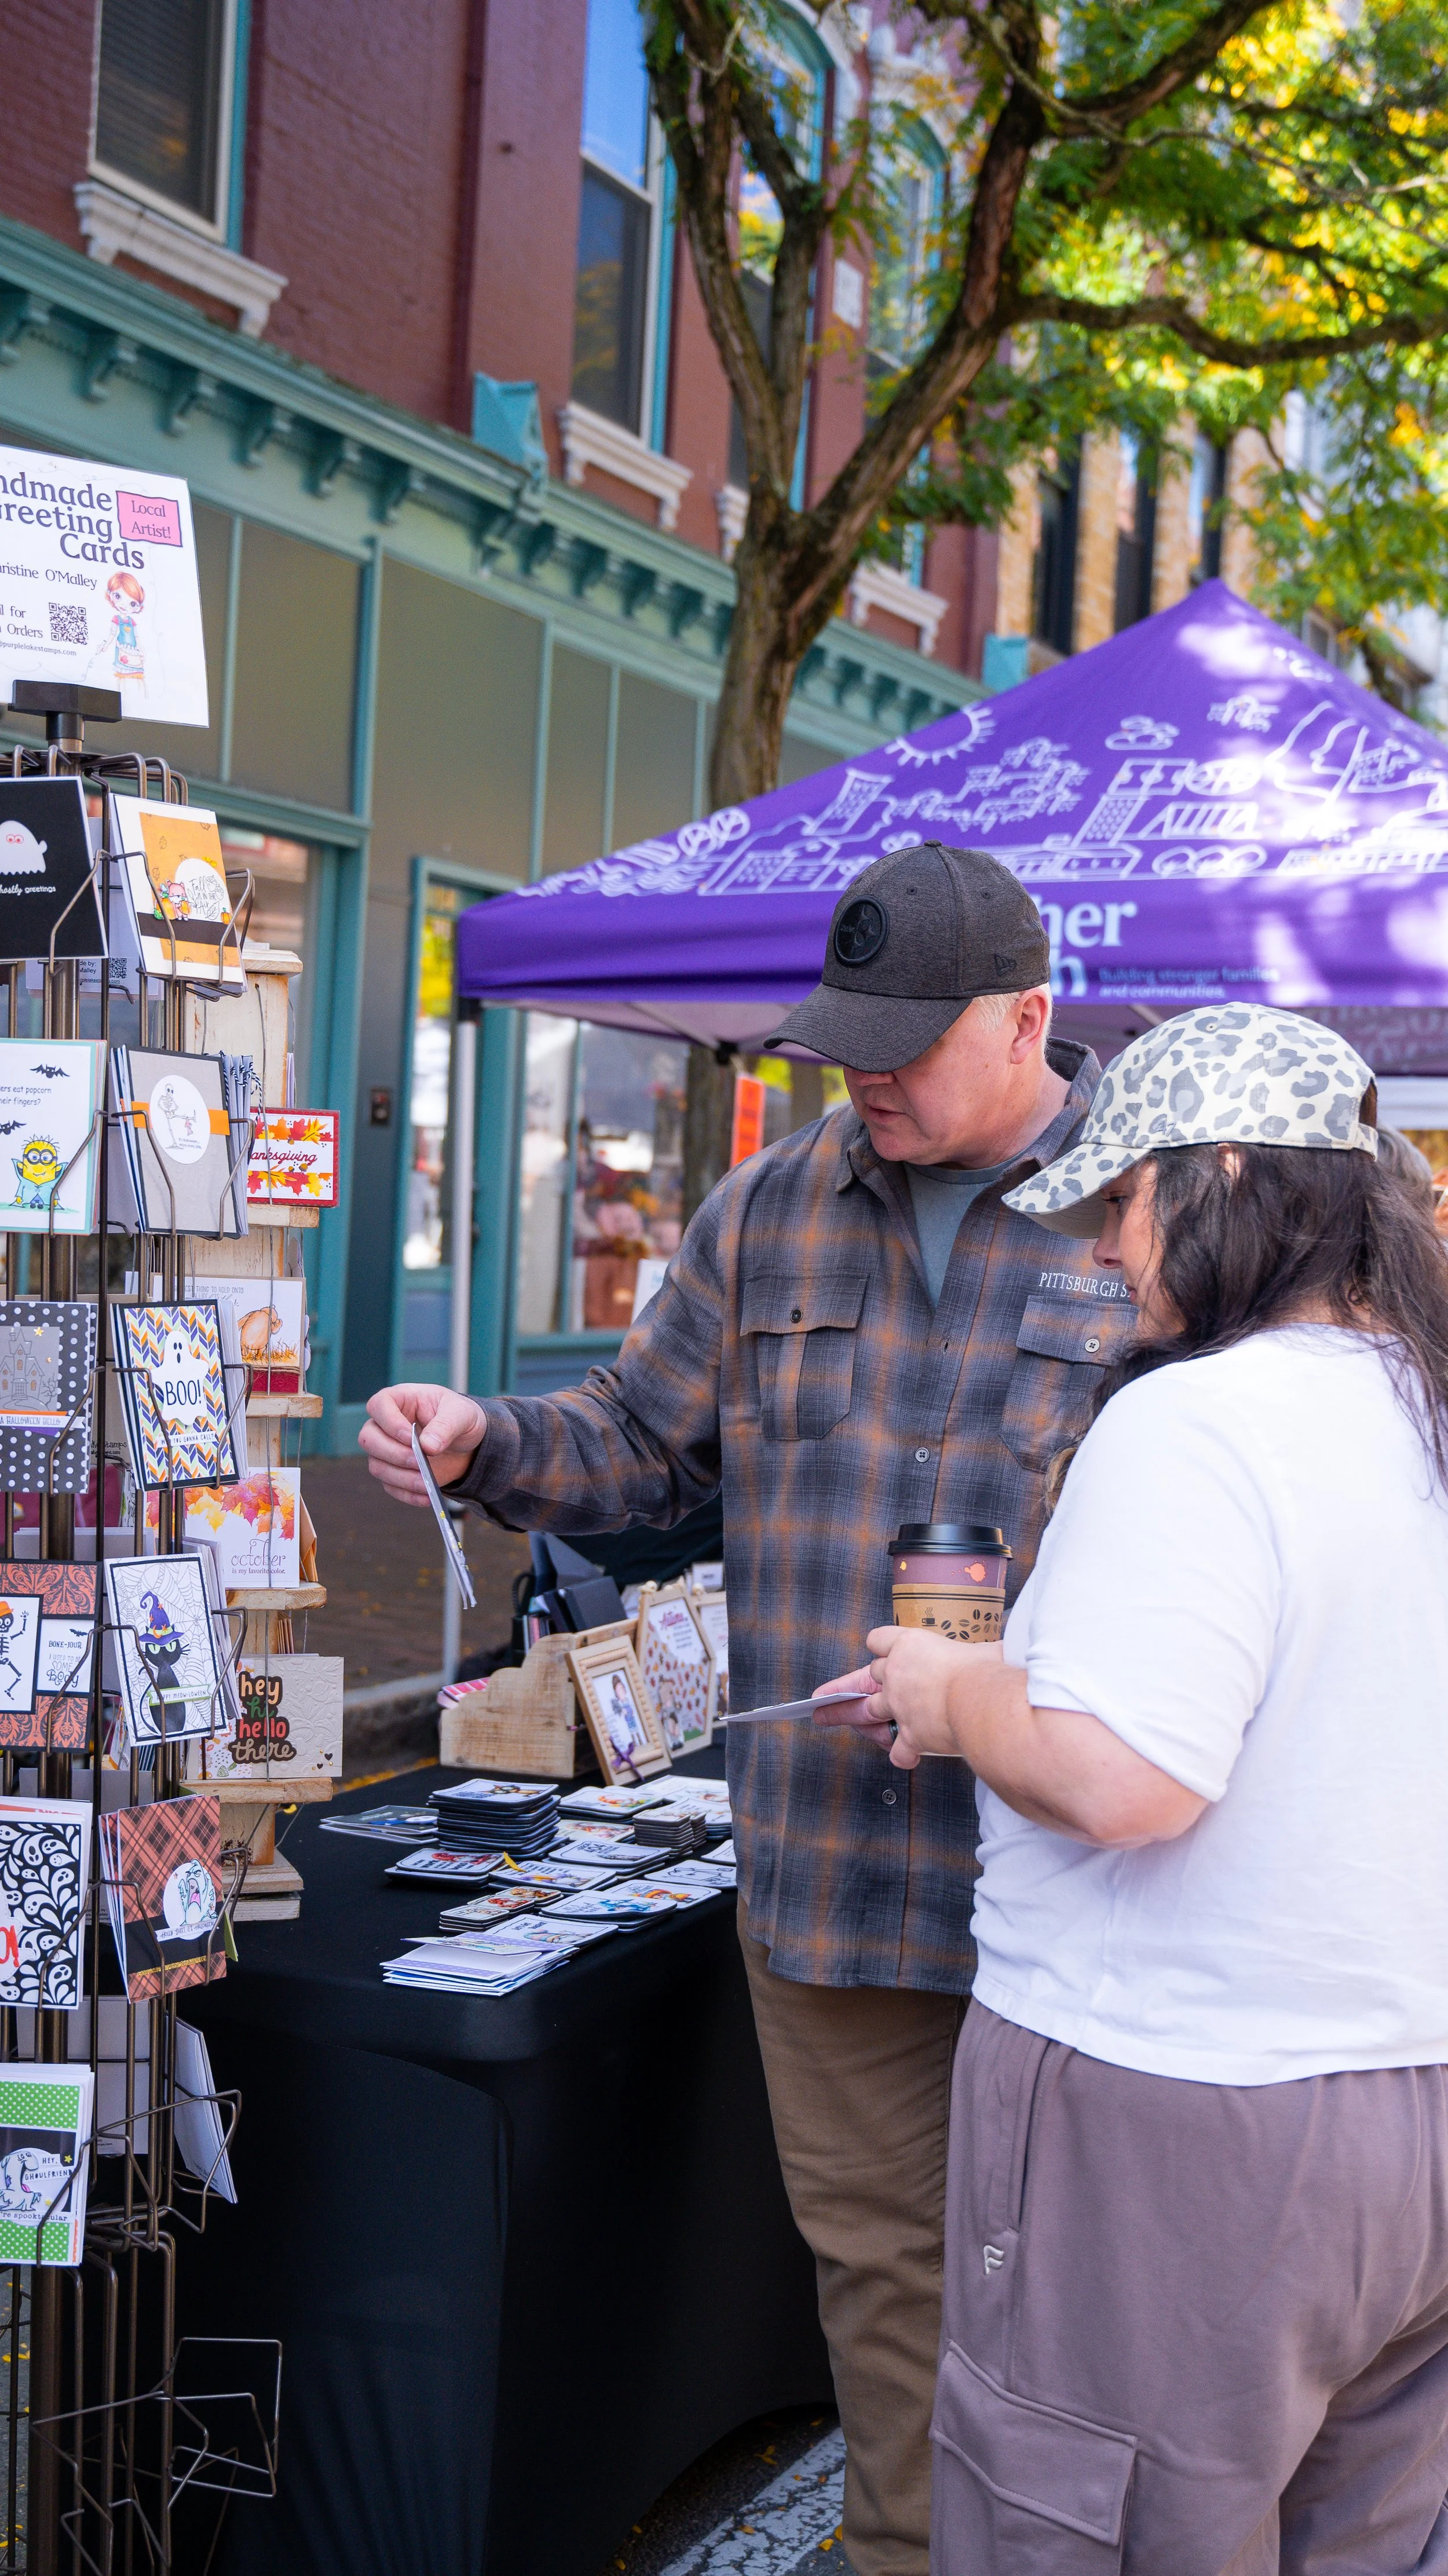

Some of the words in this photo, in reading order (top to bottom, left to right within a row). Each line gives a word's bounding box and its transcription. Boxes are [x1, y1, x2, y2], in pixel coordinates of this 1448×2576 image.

[131, 500, 166, 517] Local
[0, 503, 112, 544] reeting
[131, 521, 171, 539] Artist!
[60, 533, 144, 569] Cards
[10, 605, 26, 618] for
[7, 623, 43, 638] Orders
[24, 886, 56, 894] greetings
[25, 1087, 52, 1095] popcorn
[14, 1097, 41, 1107] fingers?
[1039, 1272, 1119, 1298] PITTSBURGH
[165, 1379, 202, 1406] BOO!
[0, 1416, 4, 1424] A
[6, 1416, 40, 1425] HALLOWEEN
[43, 1417, 60, 1426] HELLO
[105, 1441, 127, 1450] tamps
[231, 1539, 286, 1566] october
[49, 1640, 82, 1649] BONE-JOUR
[52, 1660, 73, 1672] SOME
[156, 1693, 171, 1701] HPPY
[173, 1690, 206, 1699] MEOW-LOWEEN
[241, 1674, 280, 1705] hey
[239, 1717, 287, 1738] hello
[232, 1738, 294, 1761] there
[25, 2169, 72, 2180] GHOULFRIEND
